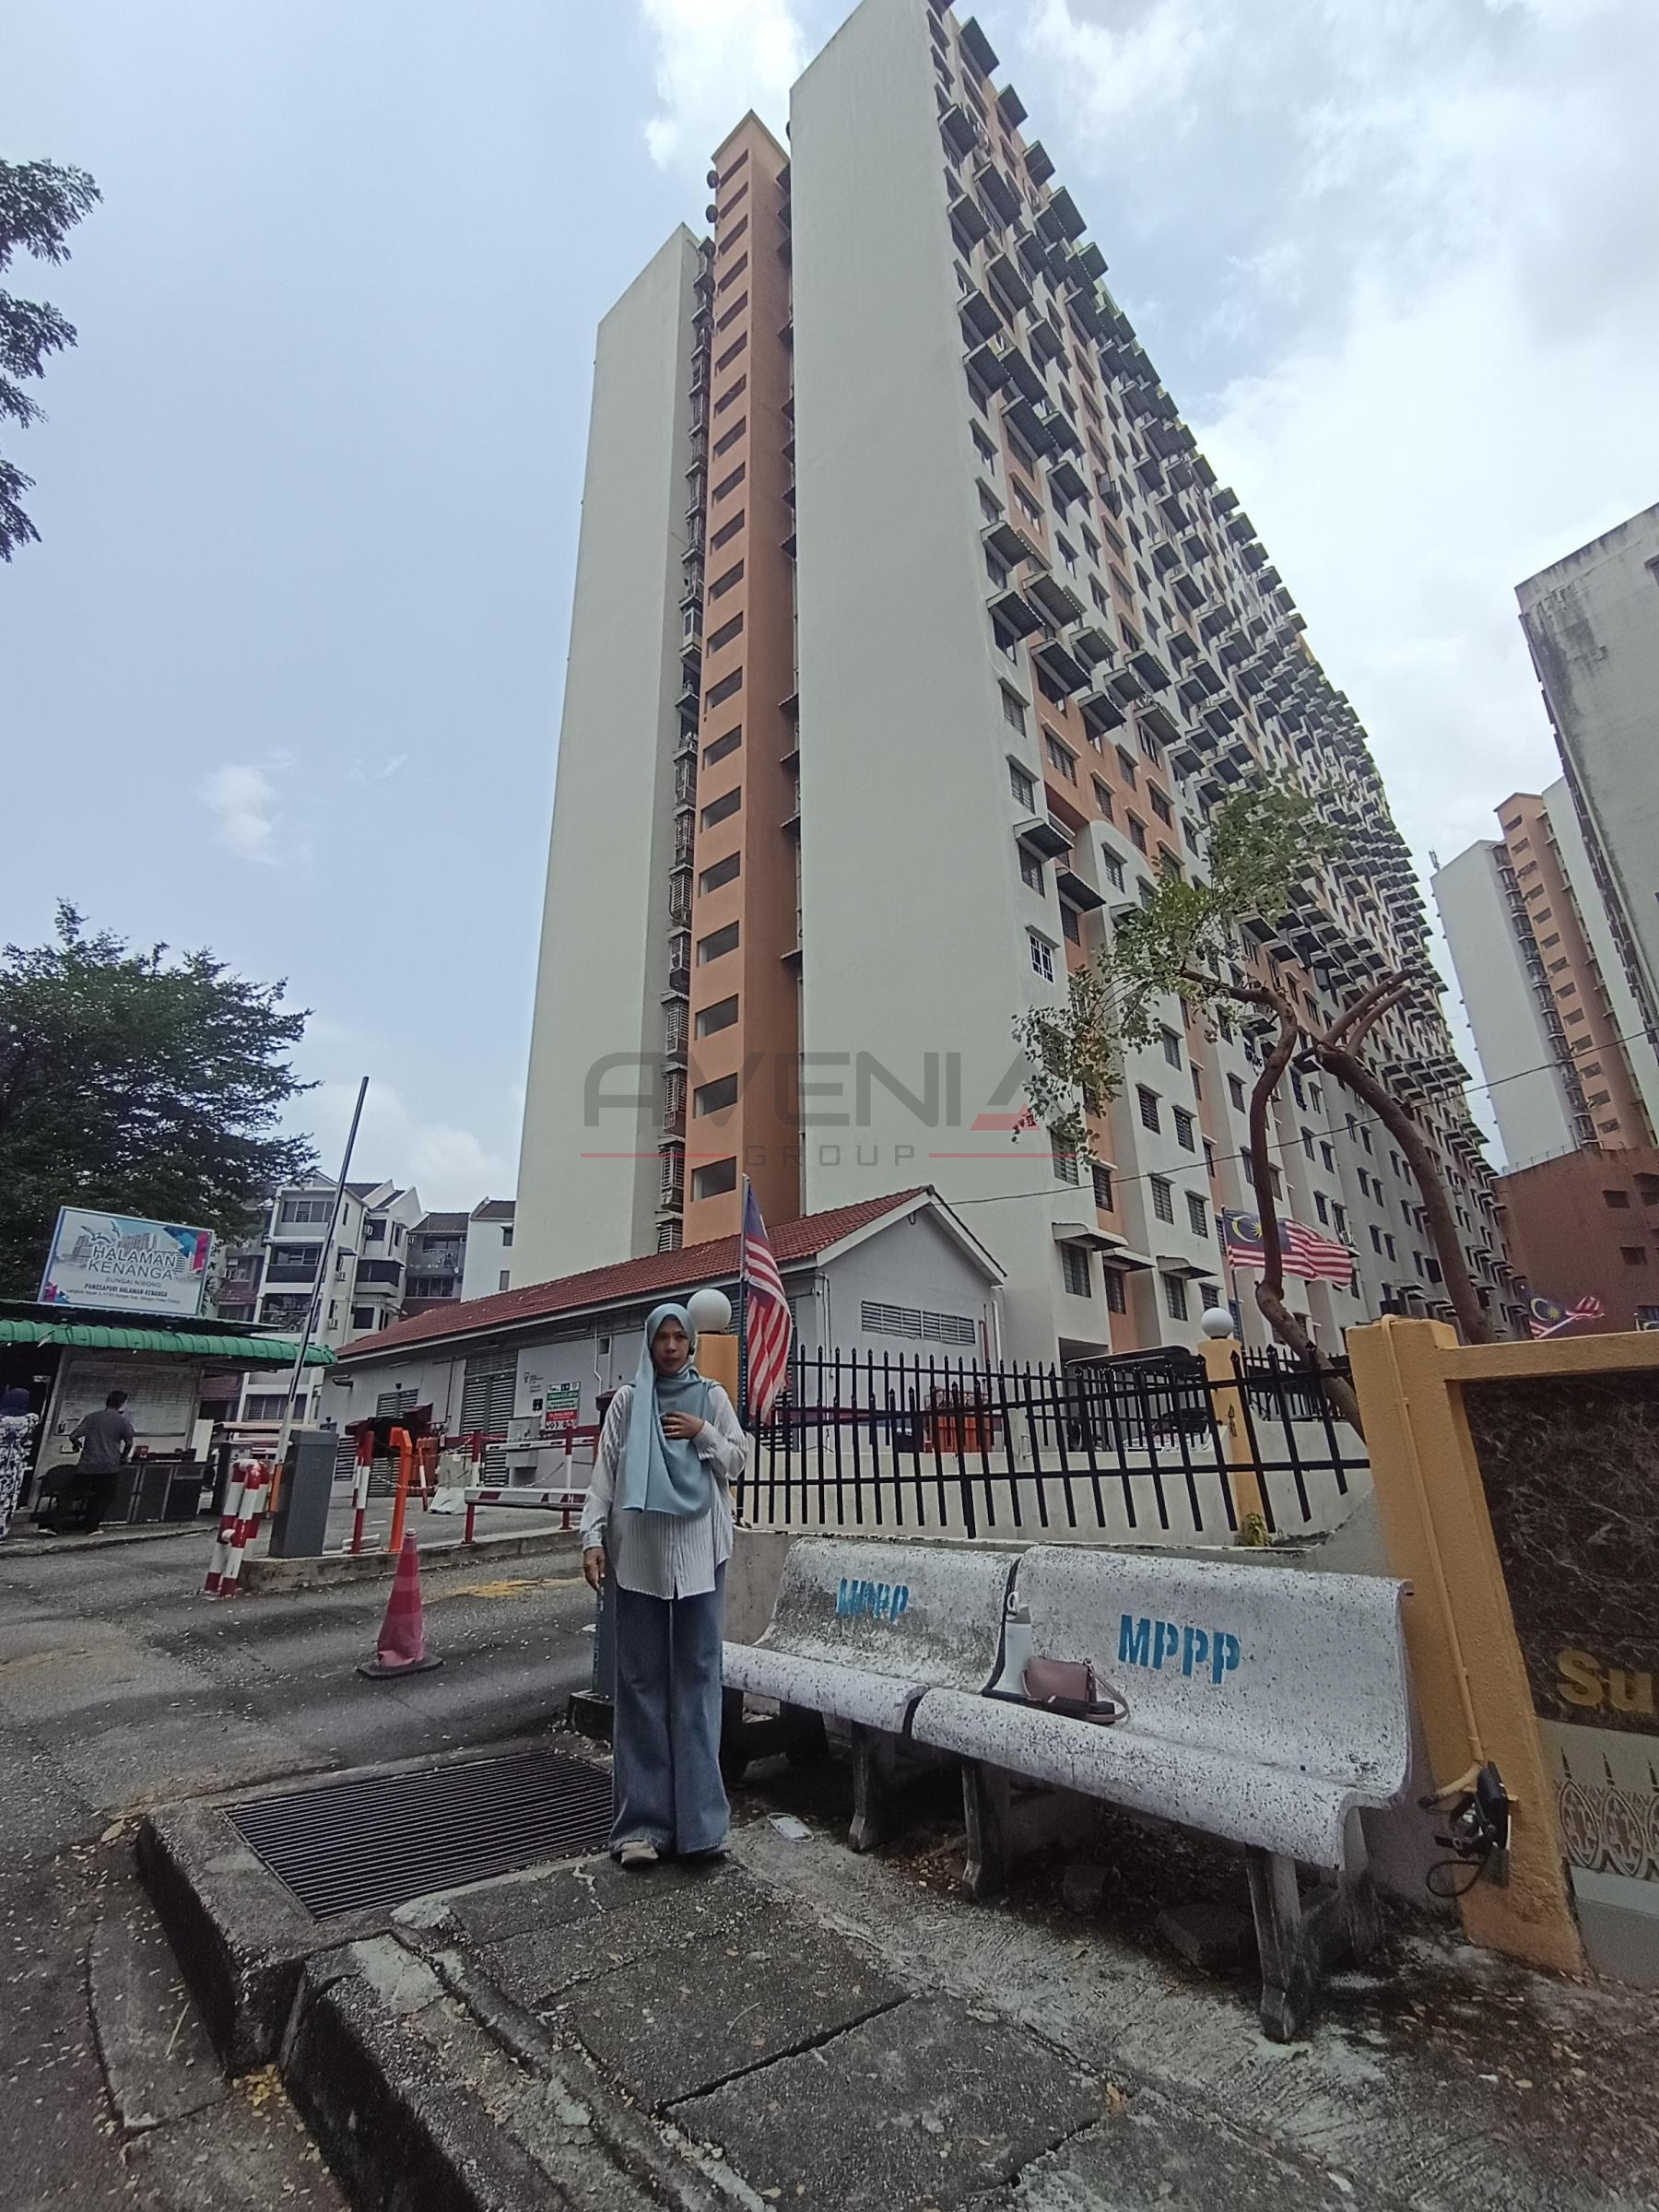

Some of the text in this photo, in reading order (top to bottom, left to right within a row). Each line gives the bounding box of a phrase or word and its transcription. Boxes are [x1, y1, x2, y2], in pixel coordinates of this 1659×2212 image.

[92, 1245, 176, 1267] HALAMAN
[88, 1259, 173, 1281] KENANGA
[105, 1277, 134, 1285] SUNGAI
[118, 1287, 144, 1295] HALAMAN
[144, 1289, 168, 1298] KENANGA
[1118, 1614, 1240, 1685] MPPP
